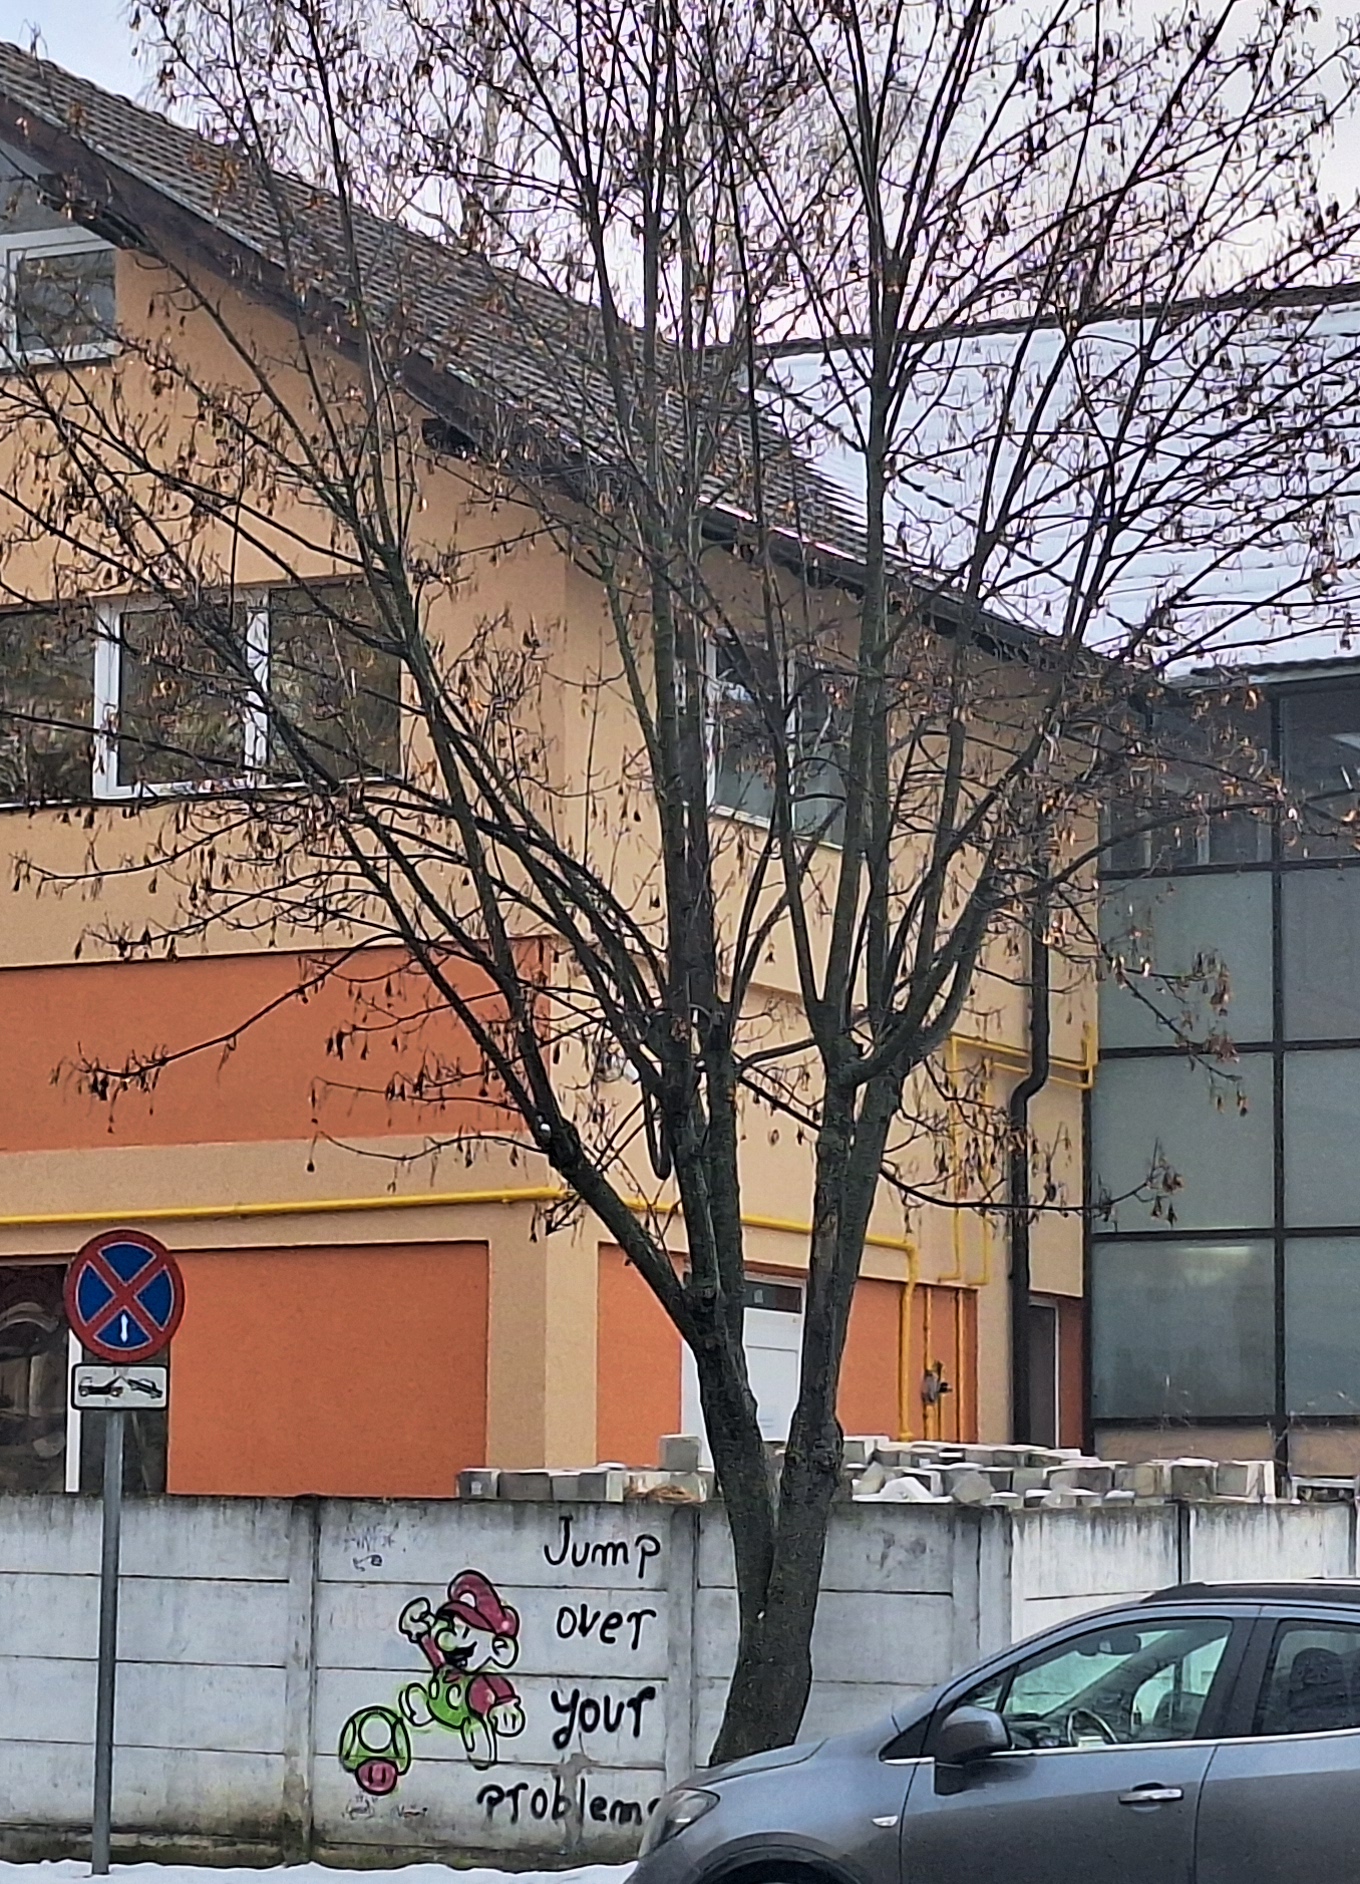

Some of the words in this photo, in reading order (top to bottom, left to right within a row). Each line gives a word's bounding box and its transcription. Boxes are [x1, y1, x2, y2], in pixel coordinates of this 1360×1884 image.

[544, 1515, 661, 1579] Jump
[556, 1603, 657, 1650] over
[551, 1686, 656, 1750] your
